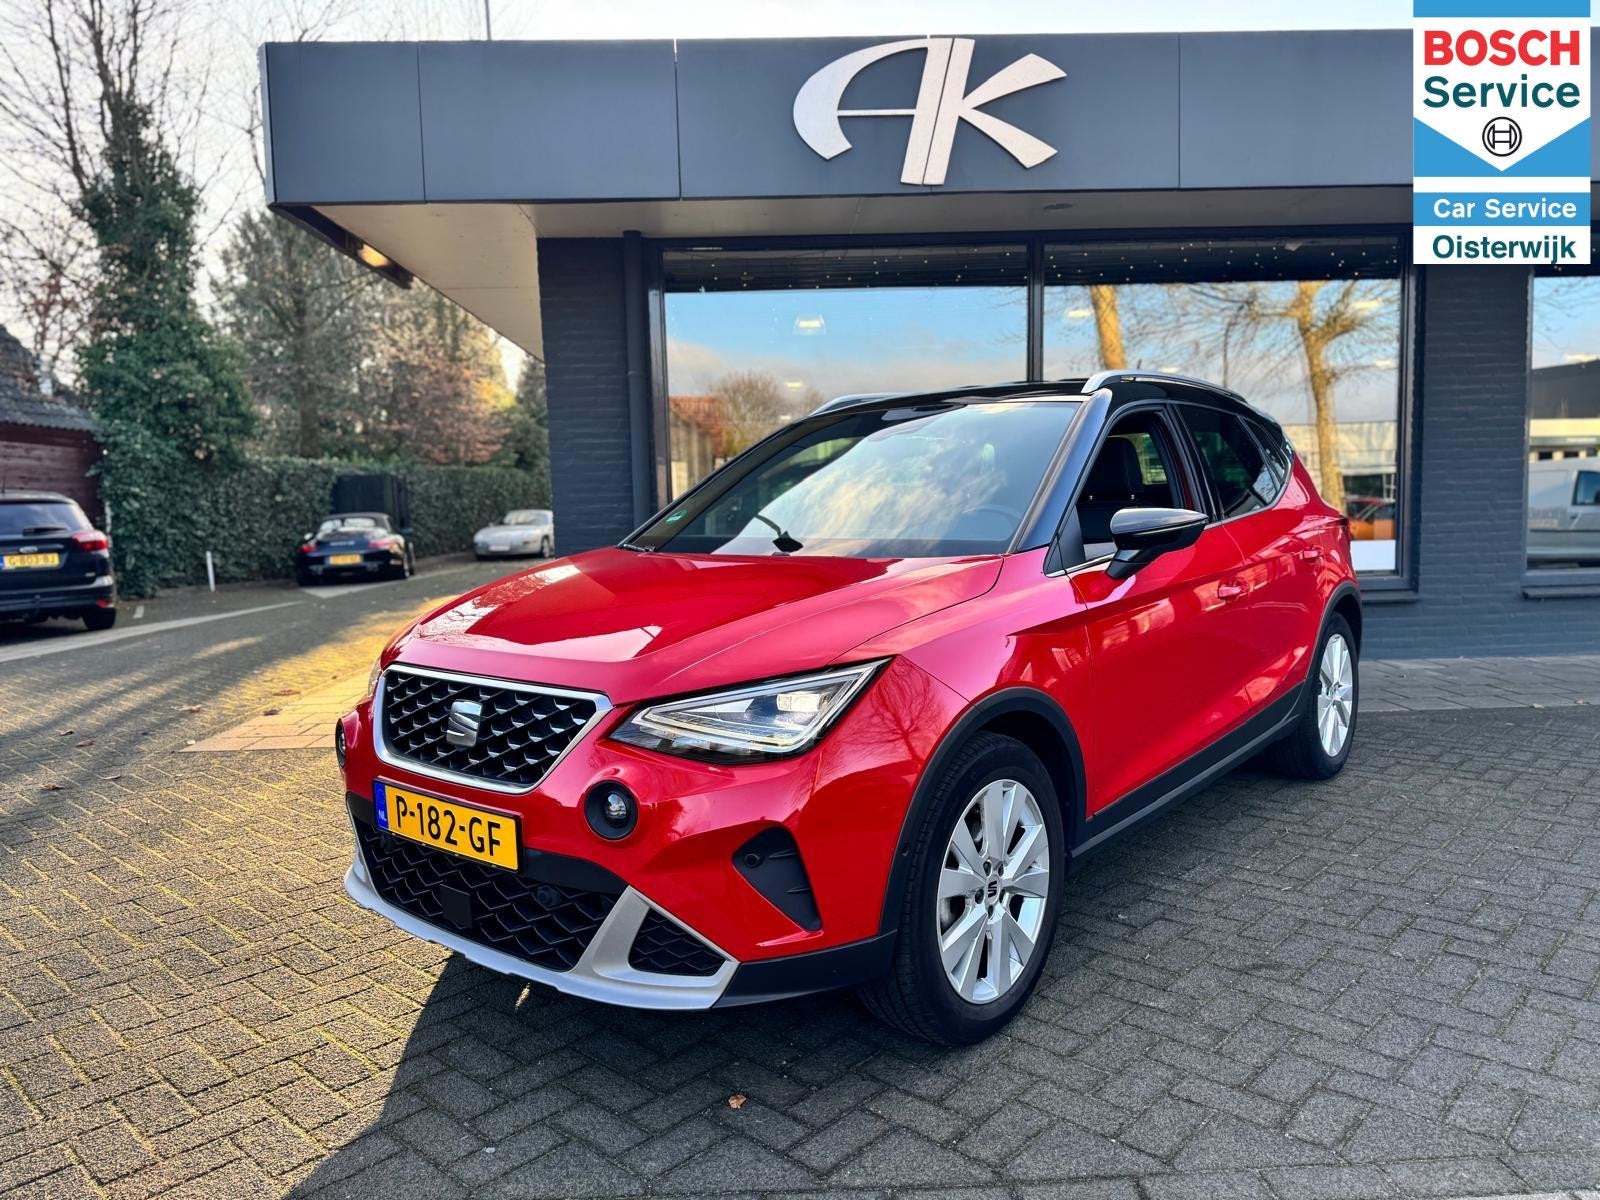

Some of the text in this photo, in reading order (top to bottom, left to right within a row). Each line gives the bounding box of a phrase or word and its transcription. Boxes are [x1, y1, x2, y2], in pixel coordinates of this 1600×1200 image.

[793, 38, 1067, 185] AK
[378, 809, 388, 822] NL
[395, 795, 501, 857] P-182-GF
